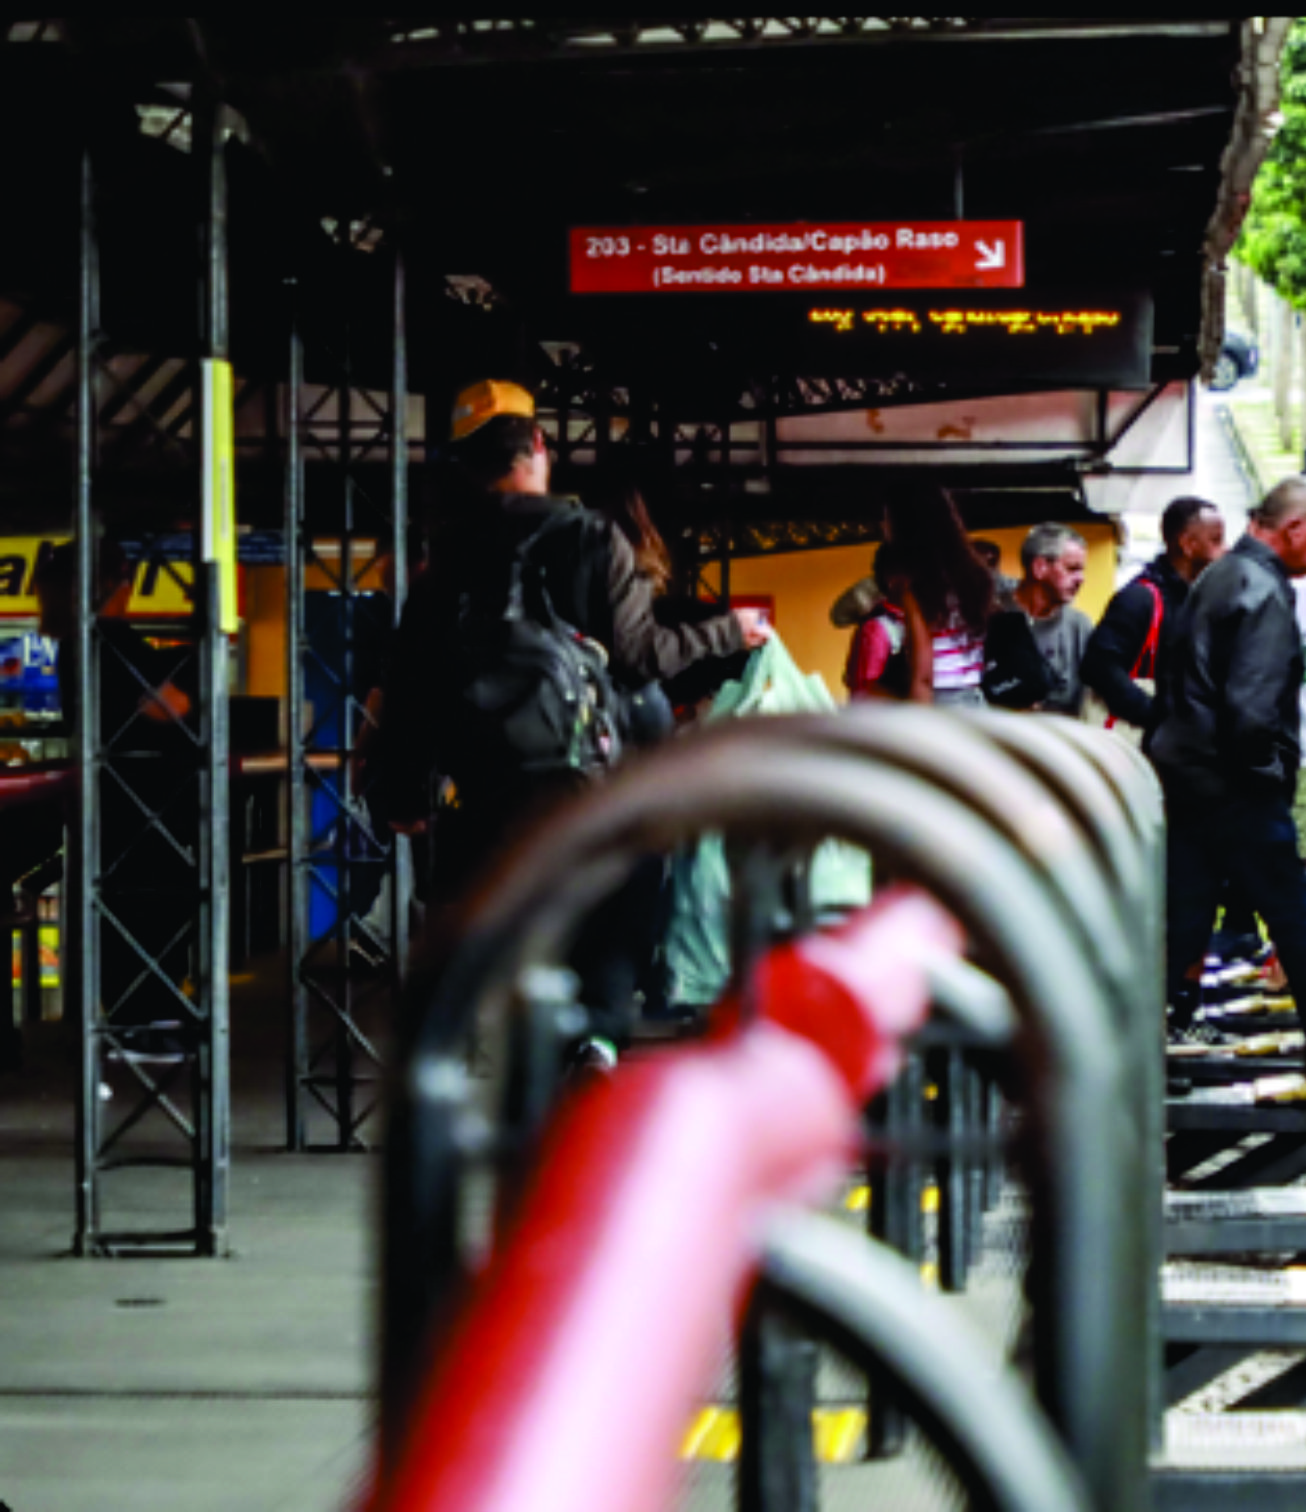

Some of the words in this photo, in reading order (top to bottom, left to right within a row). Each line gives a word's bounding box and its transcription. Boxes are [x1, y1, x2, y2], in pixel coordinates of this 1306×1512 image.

[586, 235, 631, 258] 203
[652, 233, 691, 256] Sta
[895, 227, 960, 249] Raso
[653, 265, 743, 288] (Sentido
[748, 264, 784, 284] Sta
